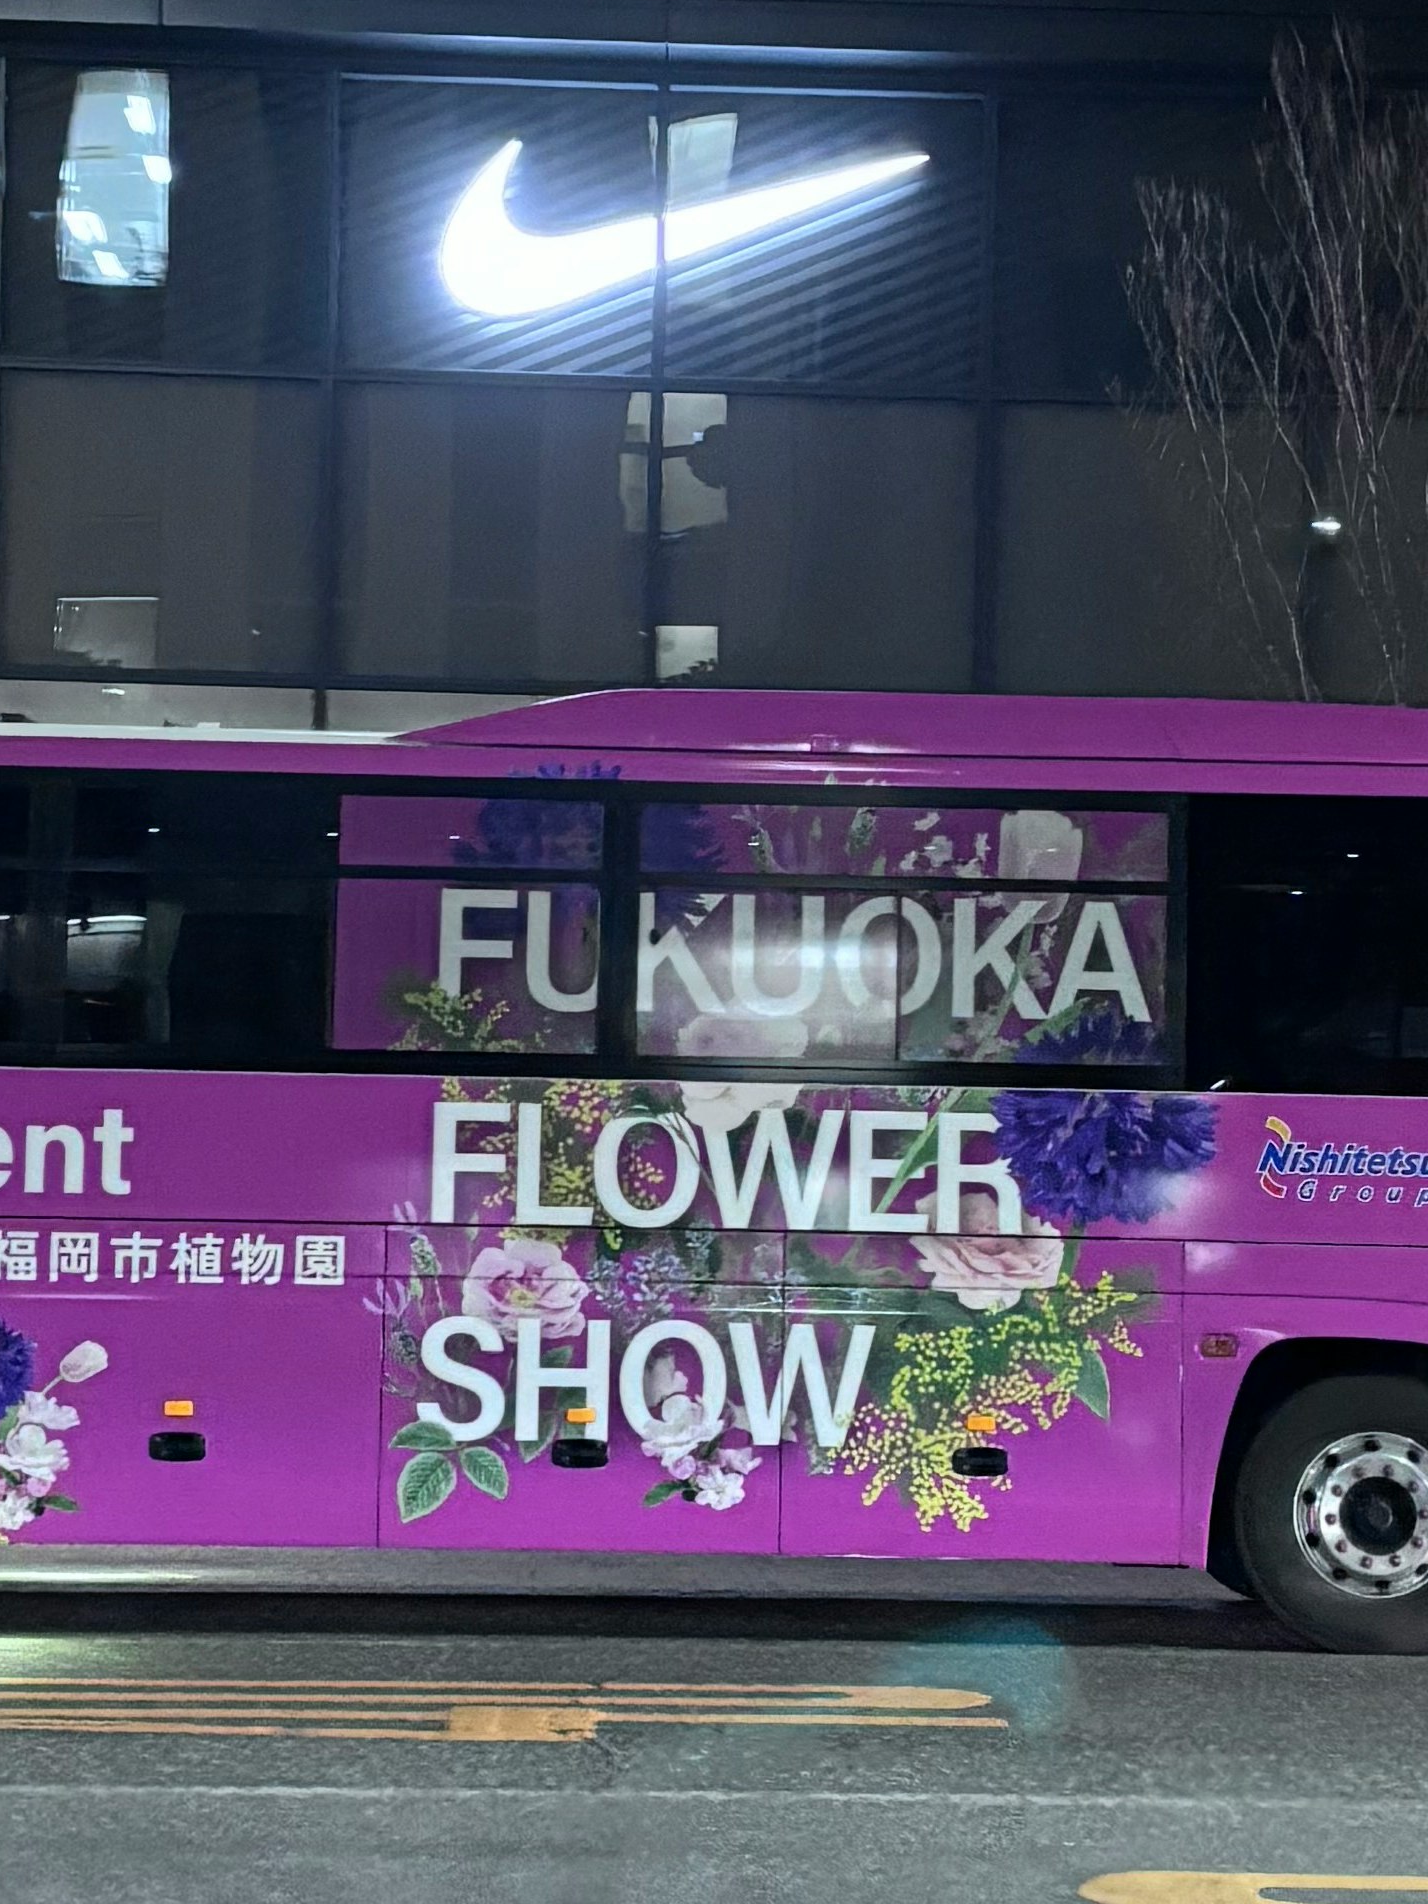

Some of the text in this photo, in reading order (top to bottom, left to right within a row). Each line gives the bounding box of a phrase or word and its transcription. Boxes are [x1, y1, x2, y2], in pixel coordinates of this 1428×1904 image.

[437, 887, 1154, 1024] FUKUOKA
[429, 1100, 1023, 1237] FLOWER
[417, 1316, 875, 1447] SHOW
